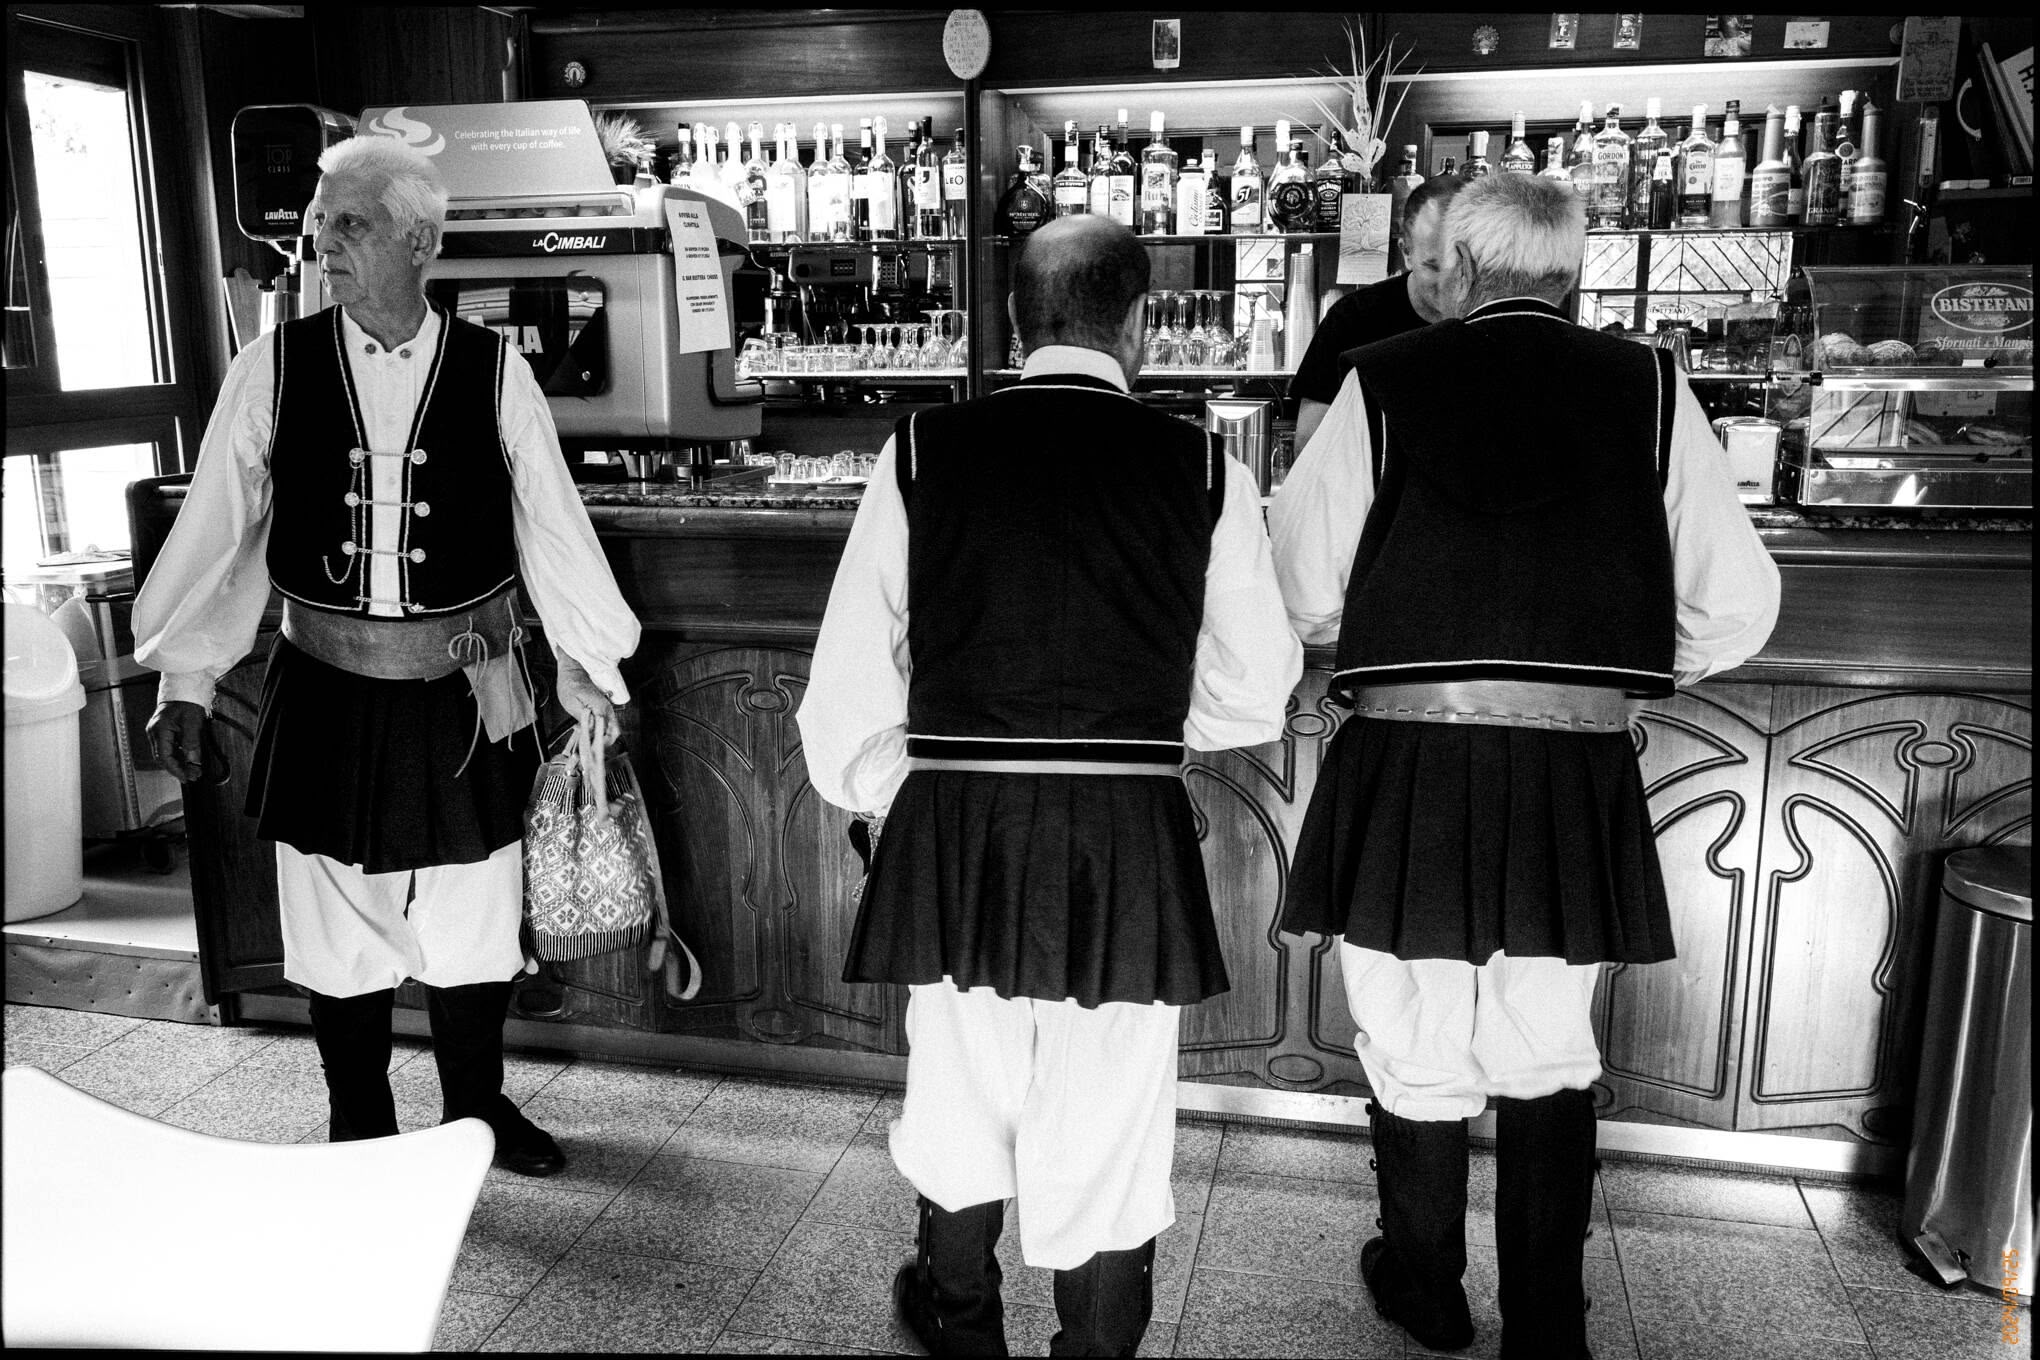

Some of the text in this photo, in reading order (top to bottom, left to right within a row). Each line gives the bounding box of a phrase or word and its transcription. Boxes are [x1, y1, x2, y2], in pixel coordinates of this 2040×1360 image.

[455, 126, 581, 140] Celebrating the Italian way of life
[471, 142, 488, 151] with
[490, 142, 510, 152] every
[513, 141, 527, 151] cup
[529, 140, 537, 149] of
[1237, 187, 1251, 203] 51
[265, 208, 299, 220] LAVAZZA
[1938, 298, 2034, 312] BISTEFANI
[1935, 336, 1981, 351] Sfornati
